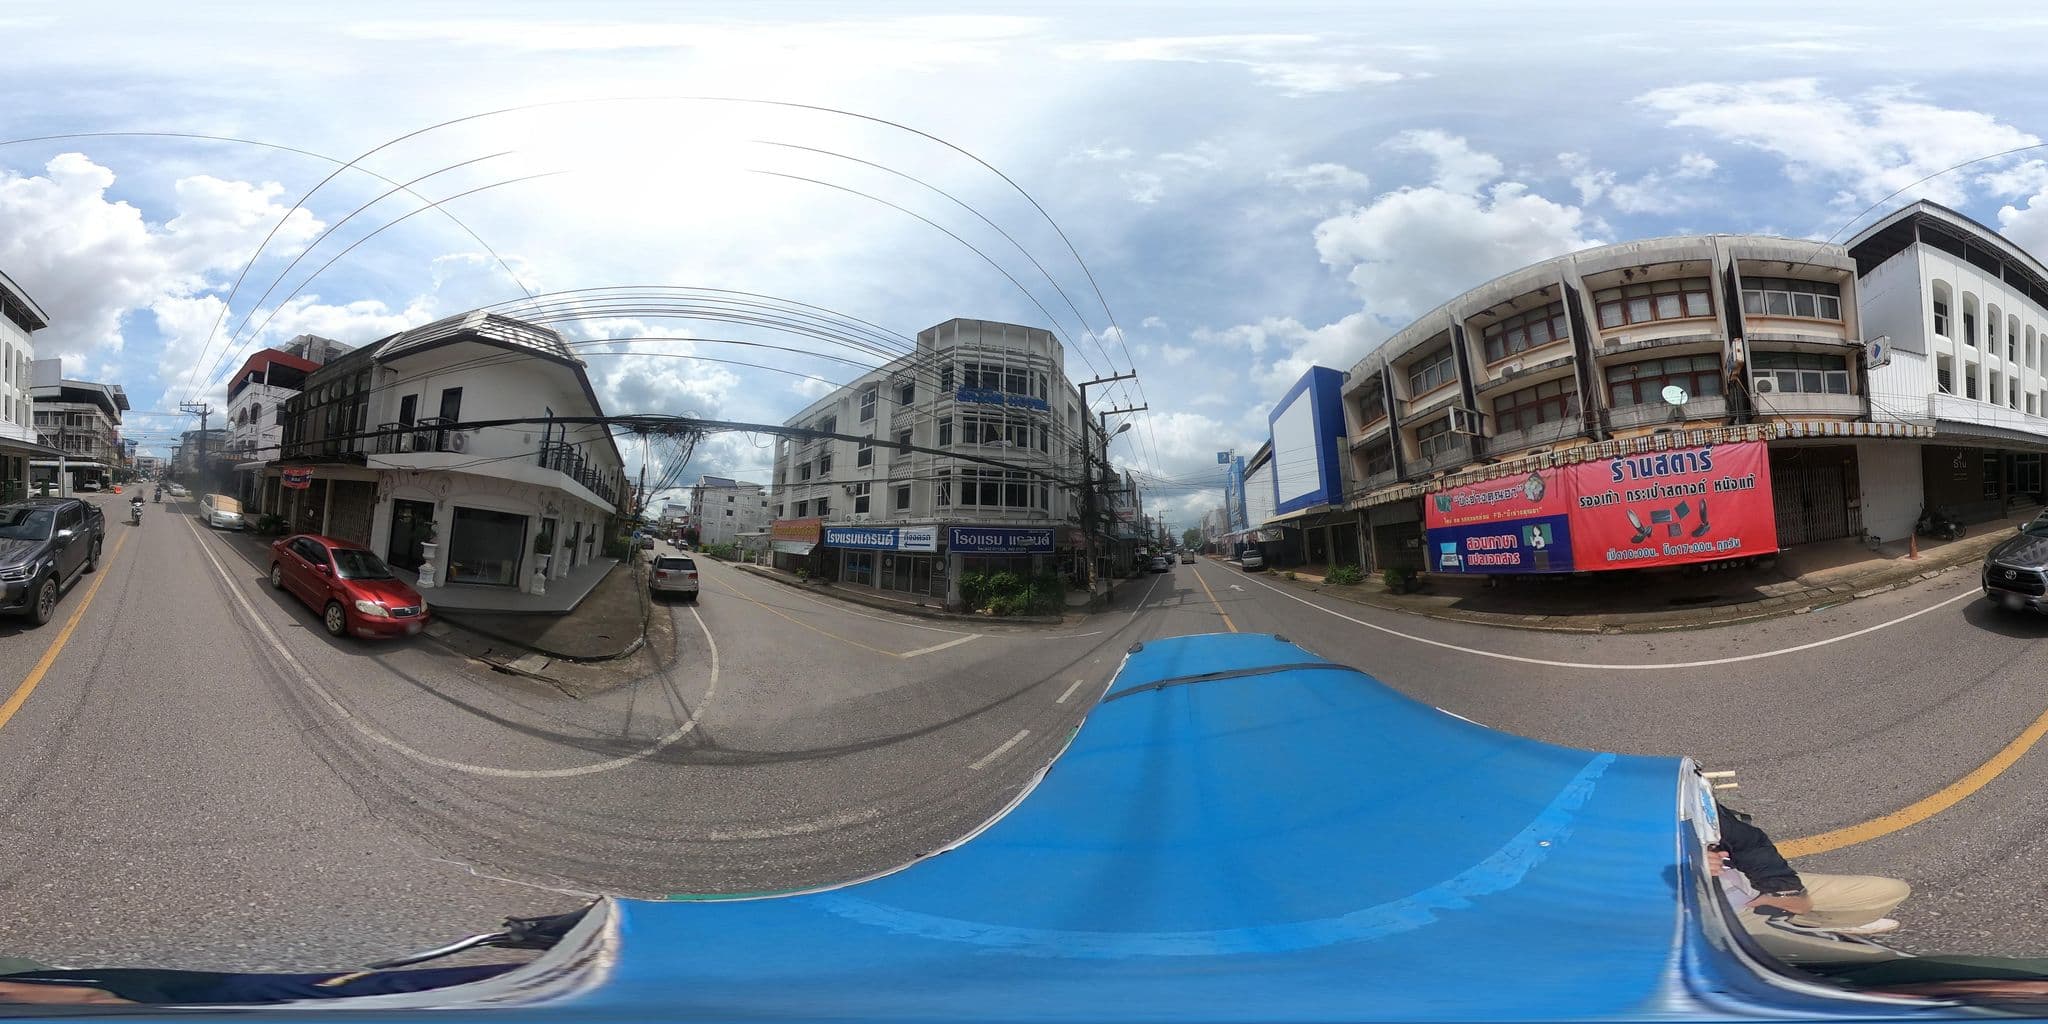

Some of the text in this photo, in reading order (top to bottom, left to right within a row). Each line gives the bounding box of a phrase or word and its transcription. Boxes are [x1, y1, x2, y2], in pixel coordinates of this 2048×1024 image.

[1611, 444, 1714, 483] ร้านสตาร์
[1579, 474, 1756, 508] รองเท้า กระเป๋าสตางค์ หนังแท้
[827, 529, 894, 546] โรงแรมแกรนด์
[953, 529, 1003, 546] โรงแรม
[1467, 534, 1518, 550] สอนภาษา
[1717, 537, 1741, 552] ทุกวัน
[1467, 552, 1521, 566] แปลเอกสาร
